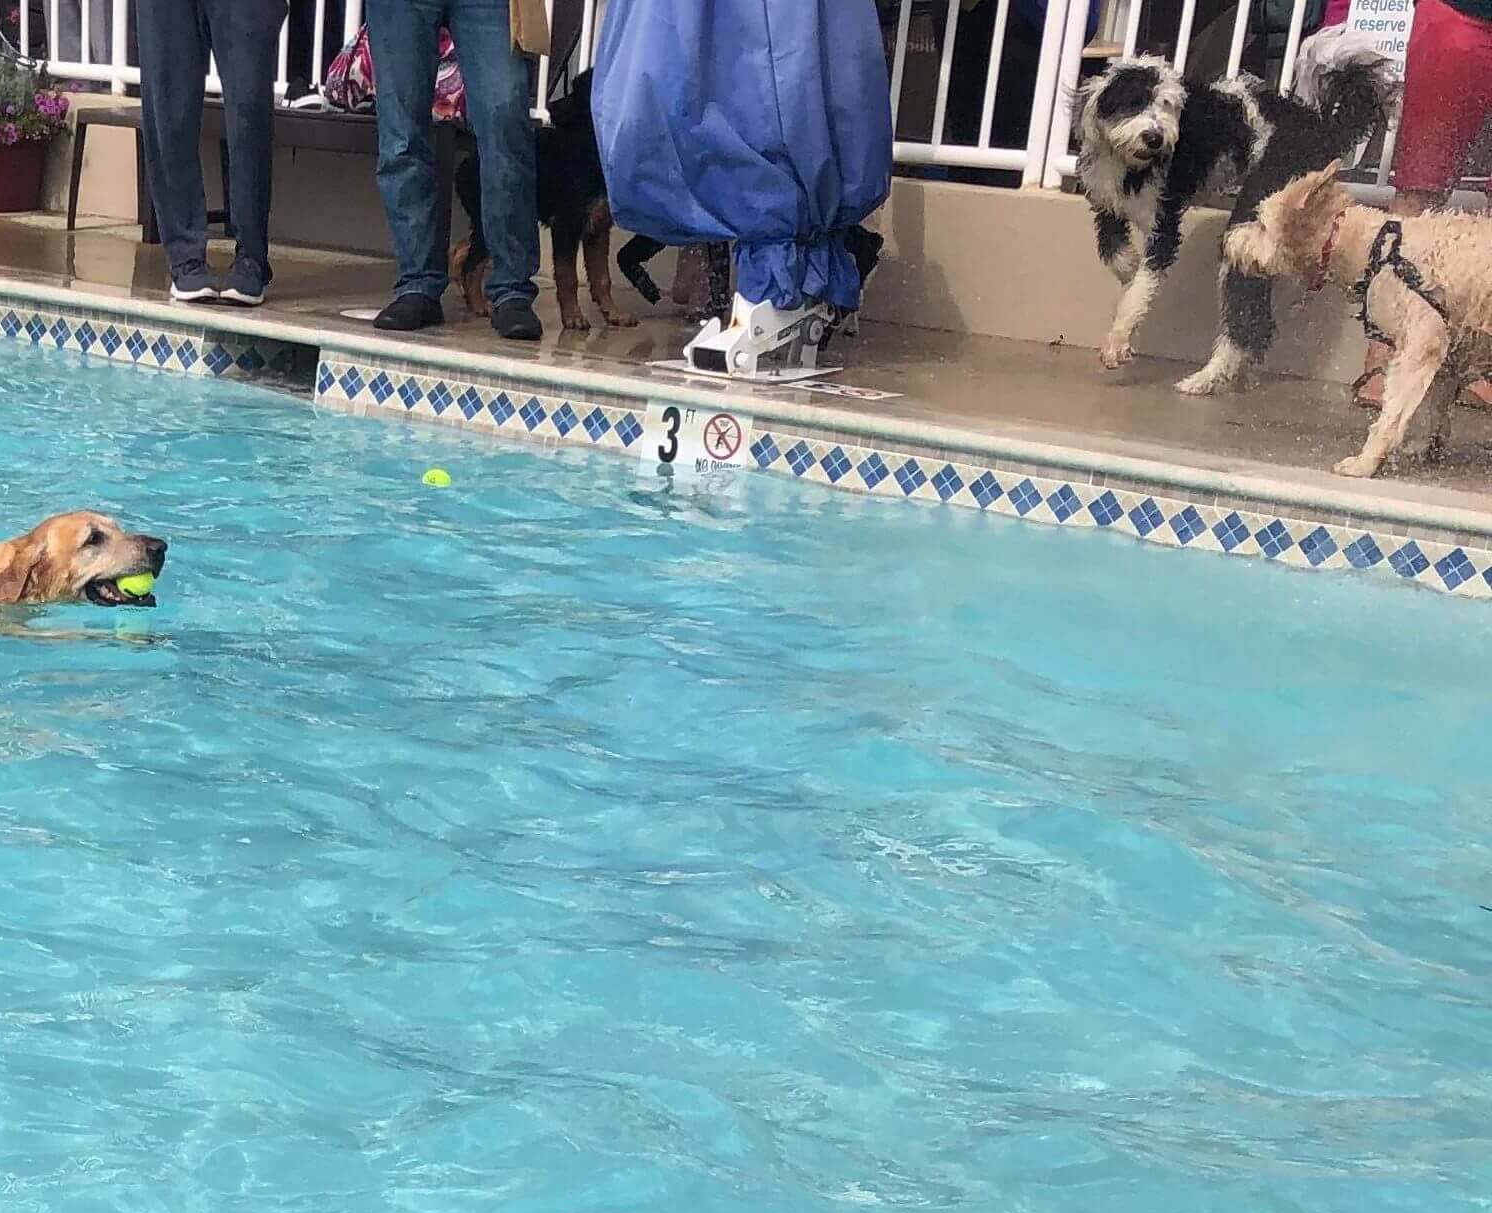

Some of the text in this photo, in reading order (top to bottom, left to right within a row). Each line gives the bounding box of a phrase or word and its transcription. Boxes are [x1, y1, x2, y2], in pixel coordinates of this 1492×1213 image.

[1355, 0, 1409, 14] request
[1354, 19, 1406, 32] reserve
[658, 406, 696, 463] 3 FT
